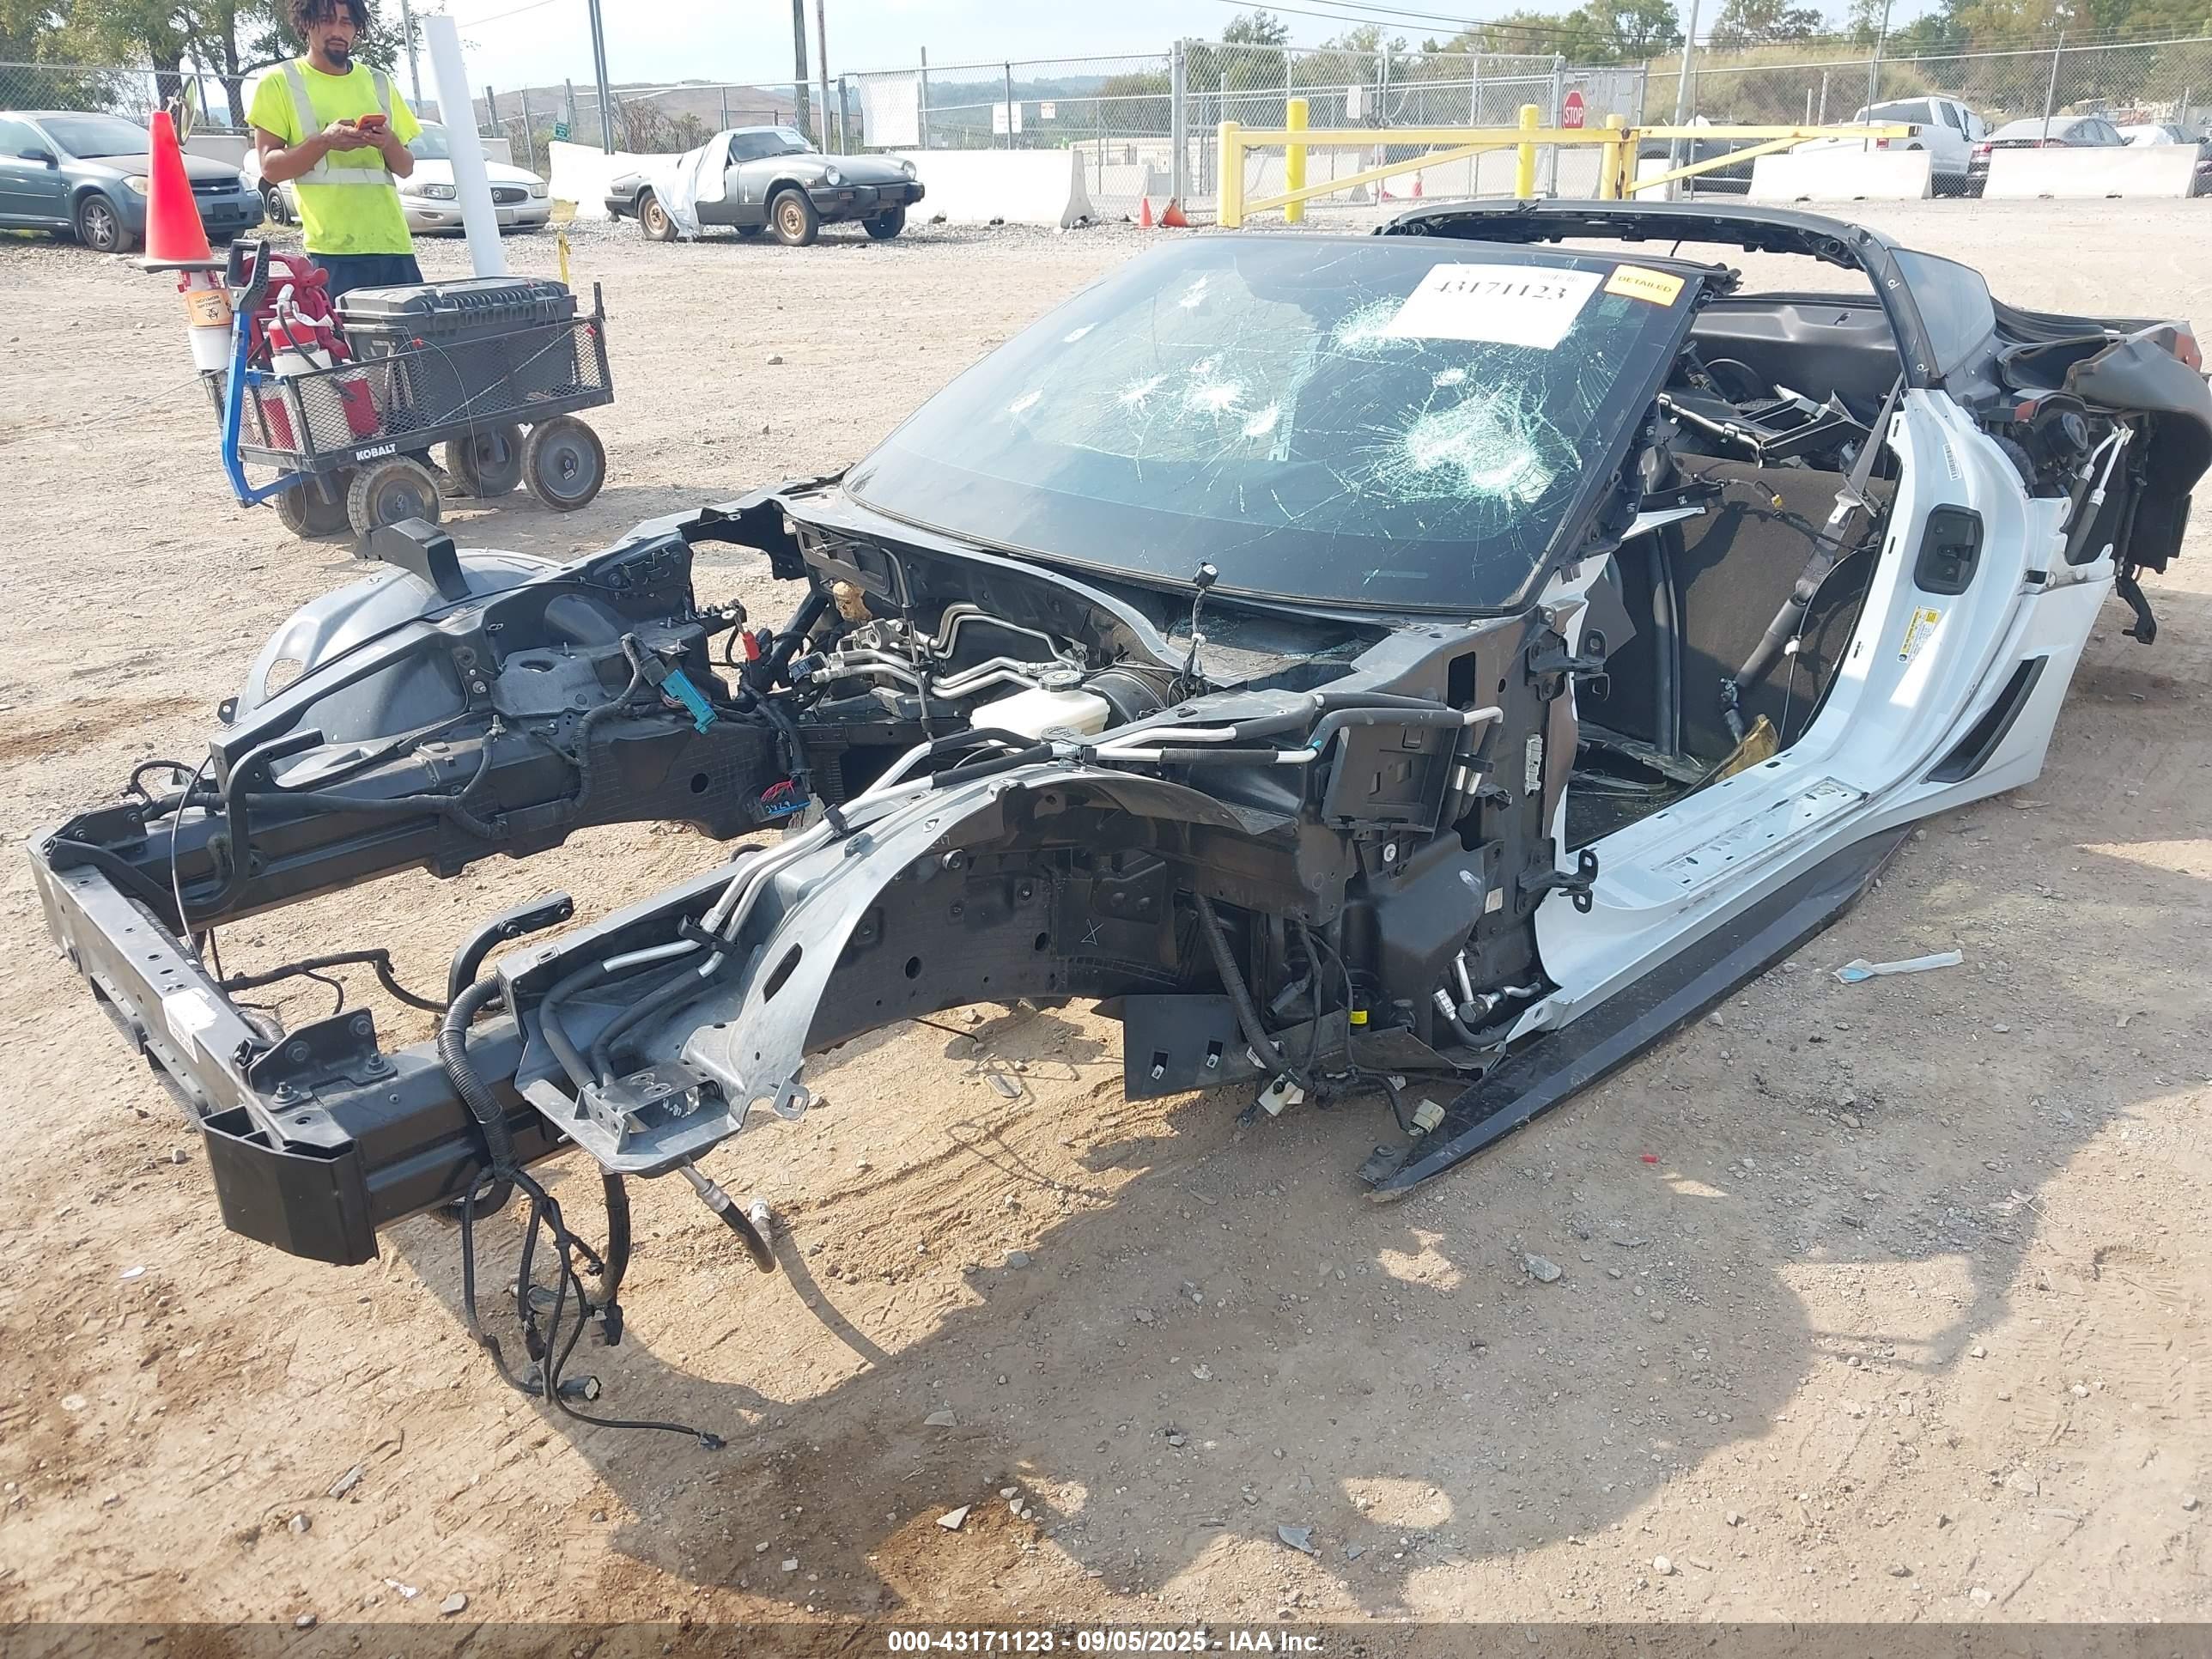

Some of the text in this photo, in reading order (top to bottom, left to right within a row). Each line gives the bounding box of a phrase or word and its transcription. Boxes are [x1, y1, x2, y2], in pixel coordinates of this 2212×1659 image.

[1565, 106, 1583, 124] STOP
[1434, 281, 1567, 300] 43171123
[1618, 276, 1672, 293] DETAILED
[356, 443, 396, 461] KOBALT
